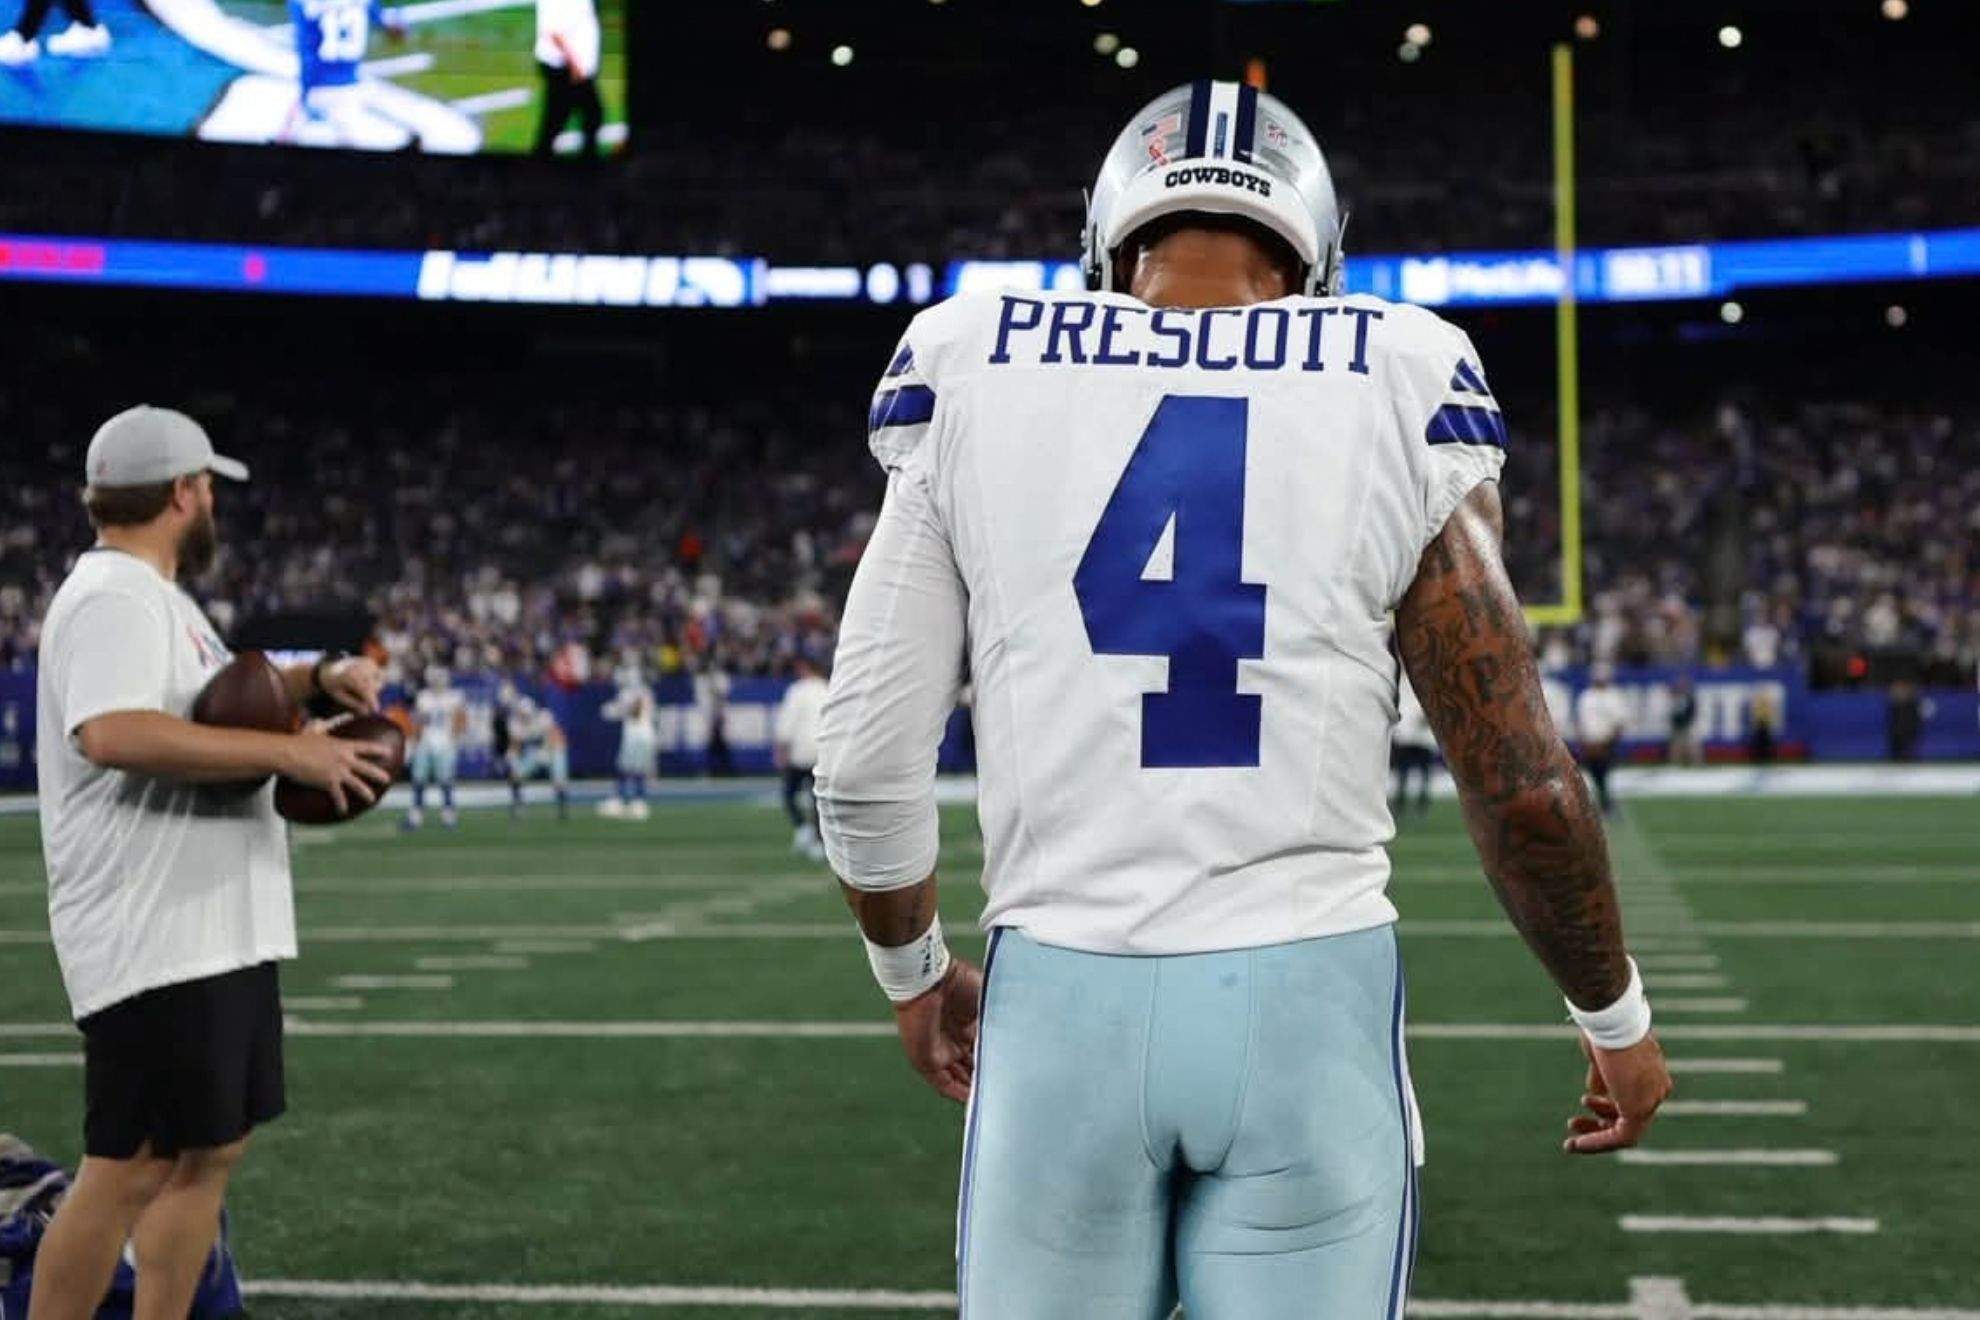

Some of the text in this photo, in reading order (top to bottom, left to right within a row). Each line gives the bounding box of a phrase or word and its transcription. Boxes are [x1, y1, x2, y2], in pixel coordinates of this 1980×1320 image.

[1164, 166, 1271, 197] COWBOYS
[988, 295, 1384, 375] PRESCOTT
[1072, 394, 1268, 768] 4
